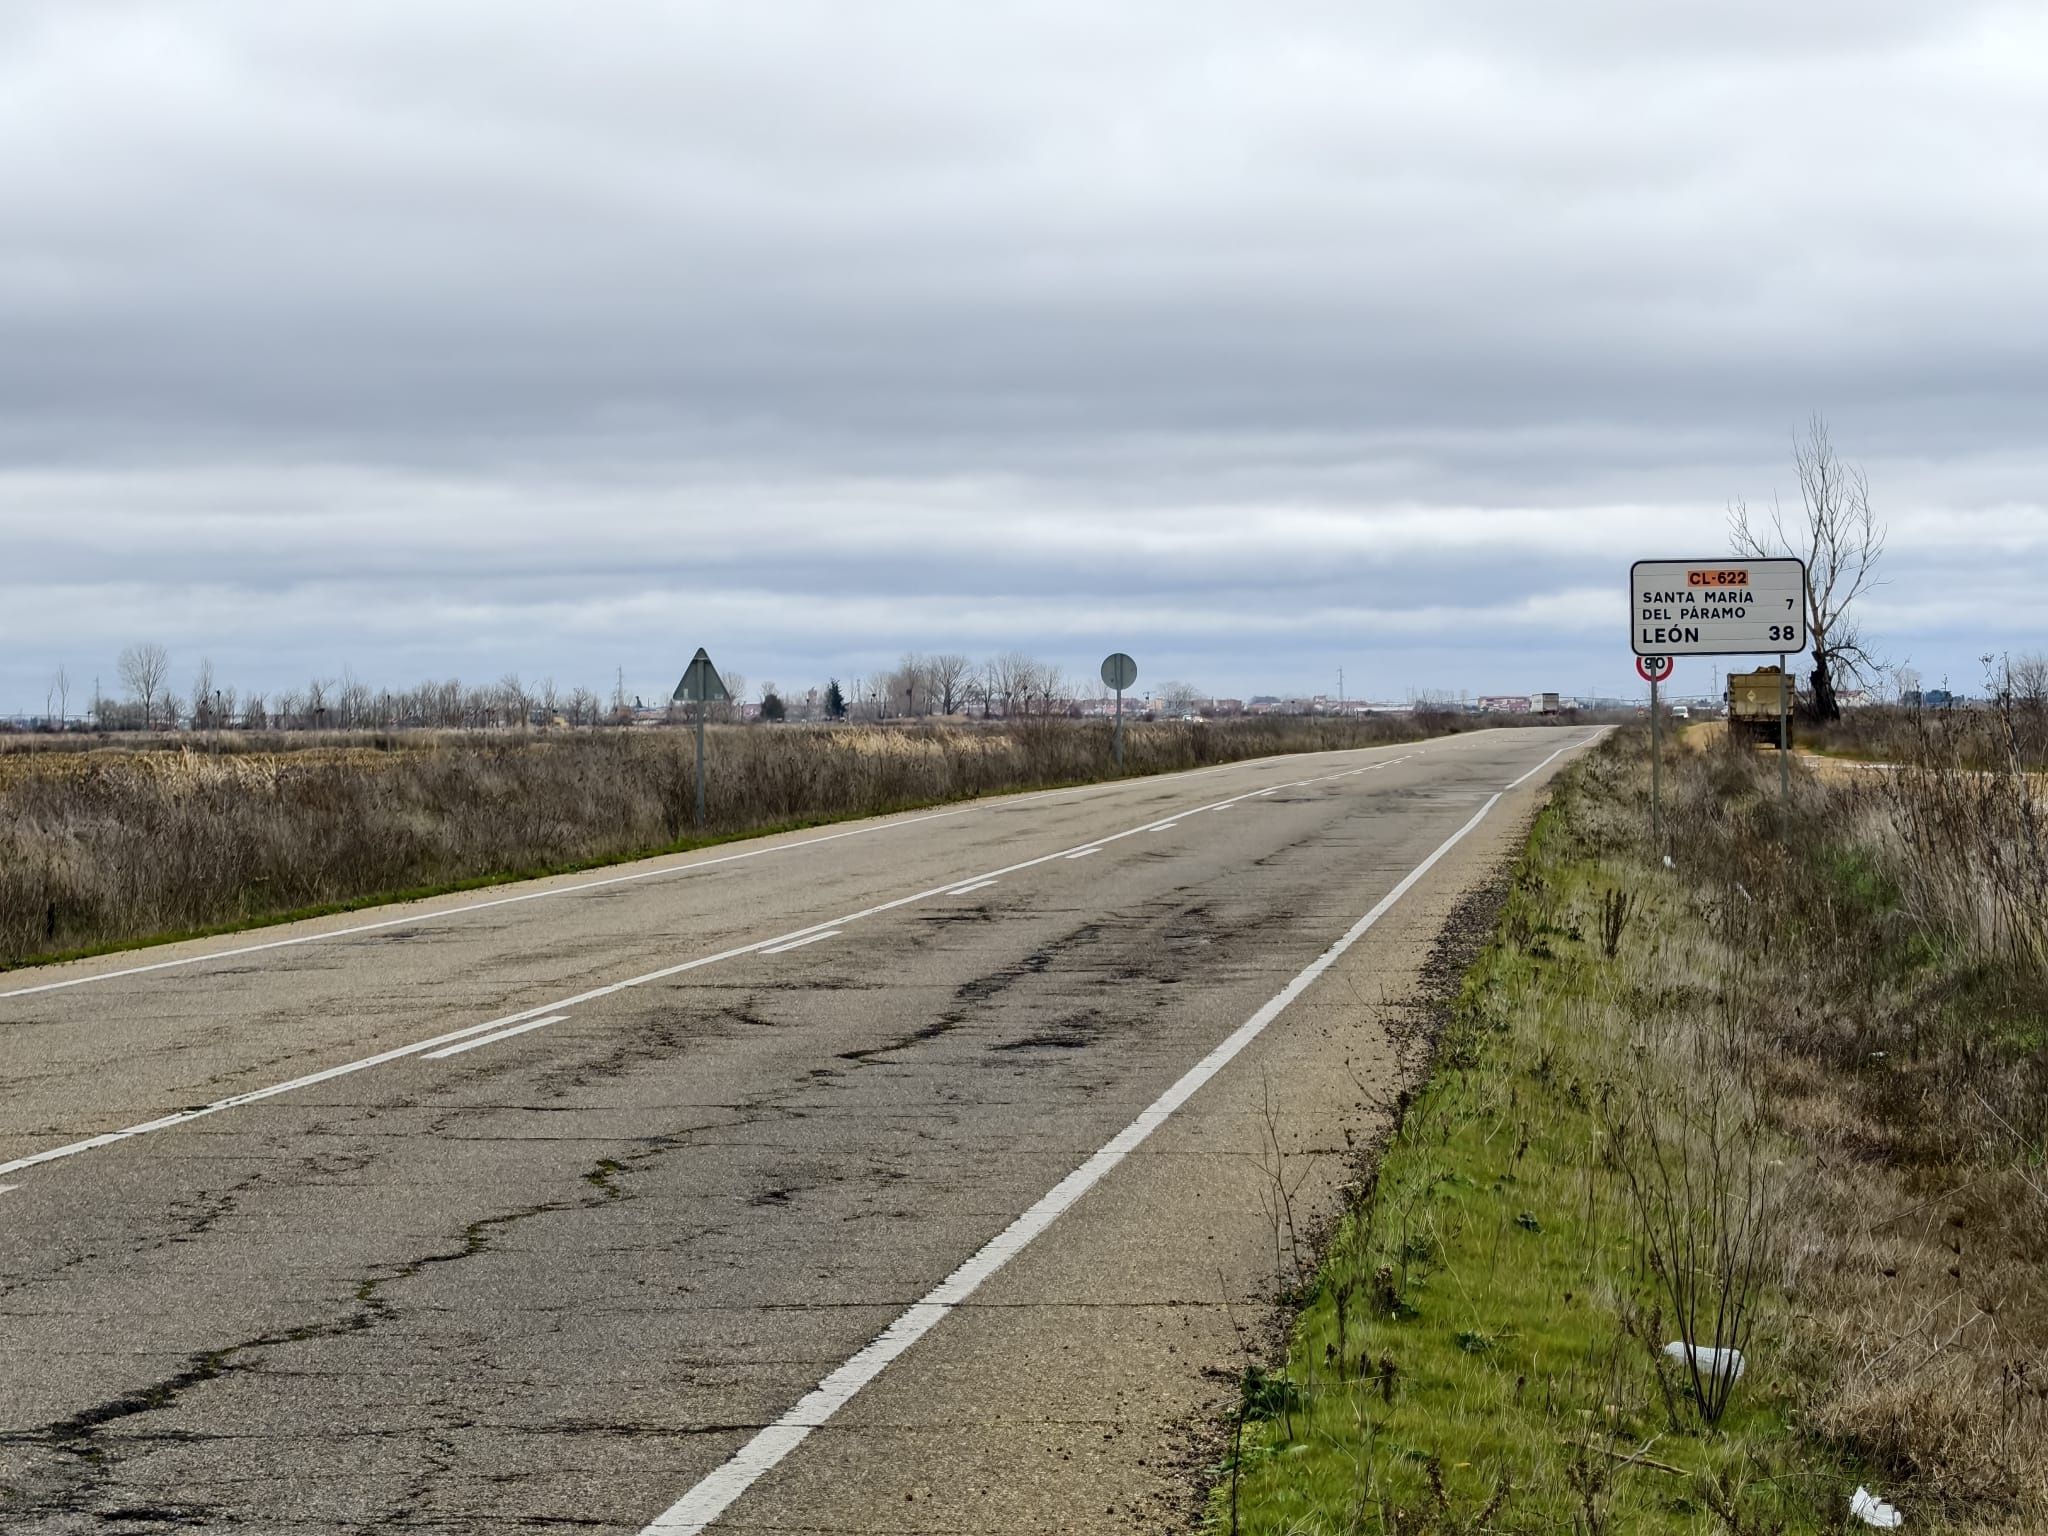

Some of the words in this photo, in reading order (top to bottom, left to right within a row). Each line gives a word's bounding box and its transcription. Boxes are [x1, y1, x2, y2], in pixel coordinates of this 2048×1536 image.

[1689, 572, 1747, 585] CL-622
[1643, 592, 1695, 603] SANTA
[1704, 589, 1753, 603] MARÍA
[1786, 598, 1794, 610] 7
[1642, 608, 1671, 620] DEL
[1680, 606, 1746, 619] PÁRAMO
[1643, 624, 1699, 643] LEÓN
[1768, 626, 1795, 641] 38
[1644, 657, 1666, 669] 90
